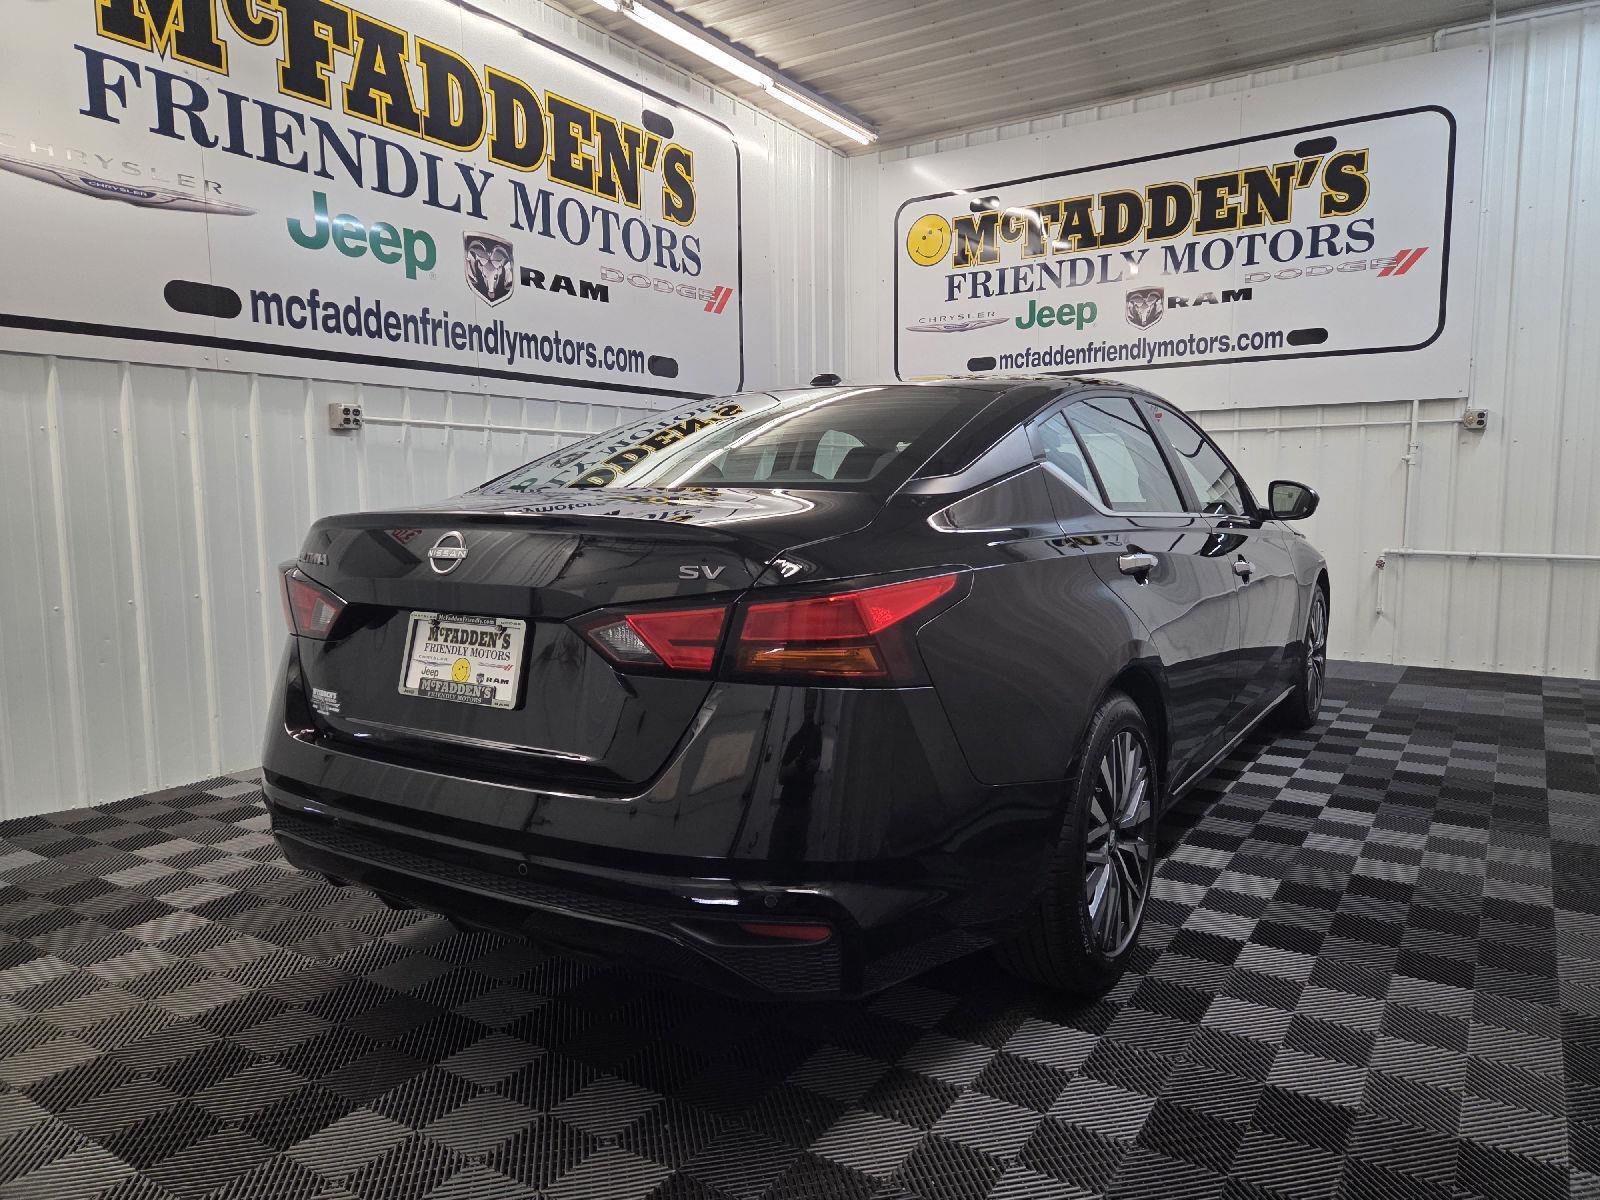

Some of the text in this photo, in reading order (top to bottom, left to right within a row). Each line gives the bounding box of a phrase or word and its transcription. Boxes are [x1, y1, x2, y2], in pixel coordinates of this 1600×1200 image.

[73, 43, 702, 278] FRIENDLY MOTORS
[286, 190, 437, 280] Jeep
[944, 217, 1376, 302] FRIENDLY MOTORS
[1244, 255, 1398, 284] DODGE
[519, 266, 610, 303] RAM
[600, 266, 717, 302] DODGE
[1167, 287, 1253, 309] RAM
[918, 311, 996, 324] CHRYSLER
[1015, 299, 1098, 331] Jeep
[249, 288, 645, 374] mcfaddenfriendlymotors.com
[999, 329, 1284, 371] mcfaddenfriendlymotors.com
[428, 549, 467, 558] NISSAN
[679, 565, 727, 580] SV
[424, 642, 512, 661] FRIENDLY MOTORS
[421, 667, 439, 677] Jeep
[486, 677, 510, 685] RAM
[427, 691, 482, 704] FRIENDLY MOTORS
